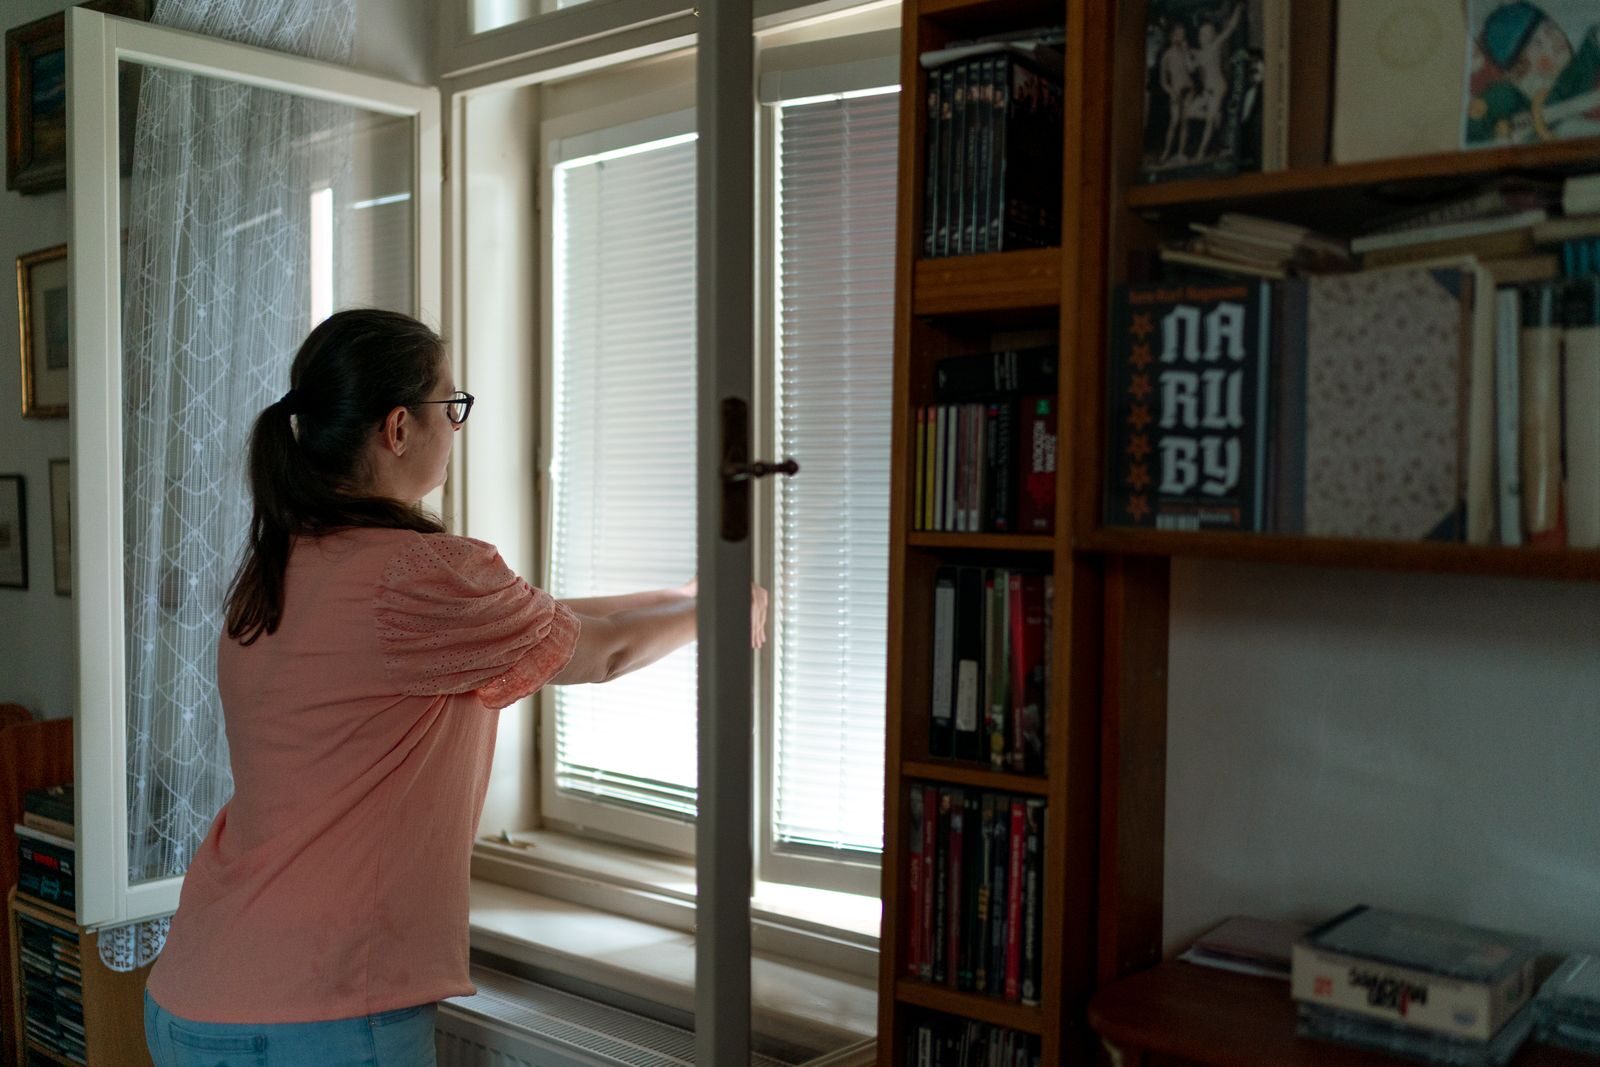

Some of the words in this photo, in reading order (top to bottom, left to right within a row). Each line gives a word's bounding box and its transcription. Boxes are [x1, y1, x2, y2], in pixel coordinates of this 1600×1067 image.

[1160, 302, 1246, 363] NA
[1159, 368, 1244, 429] RU
[1158, 435, 1241, 497] BY
